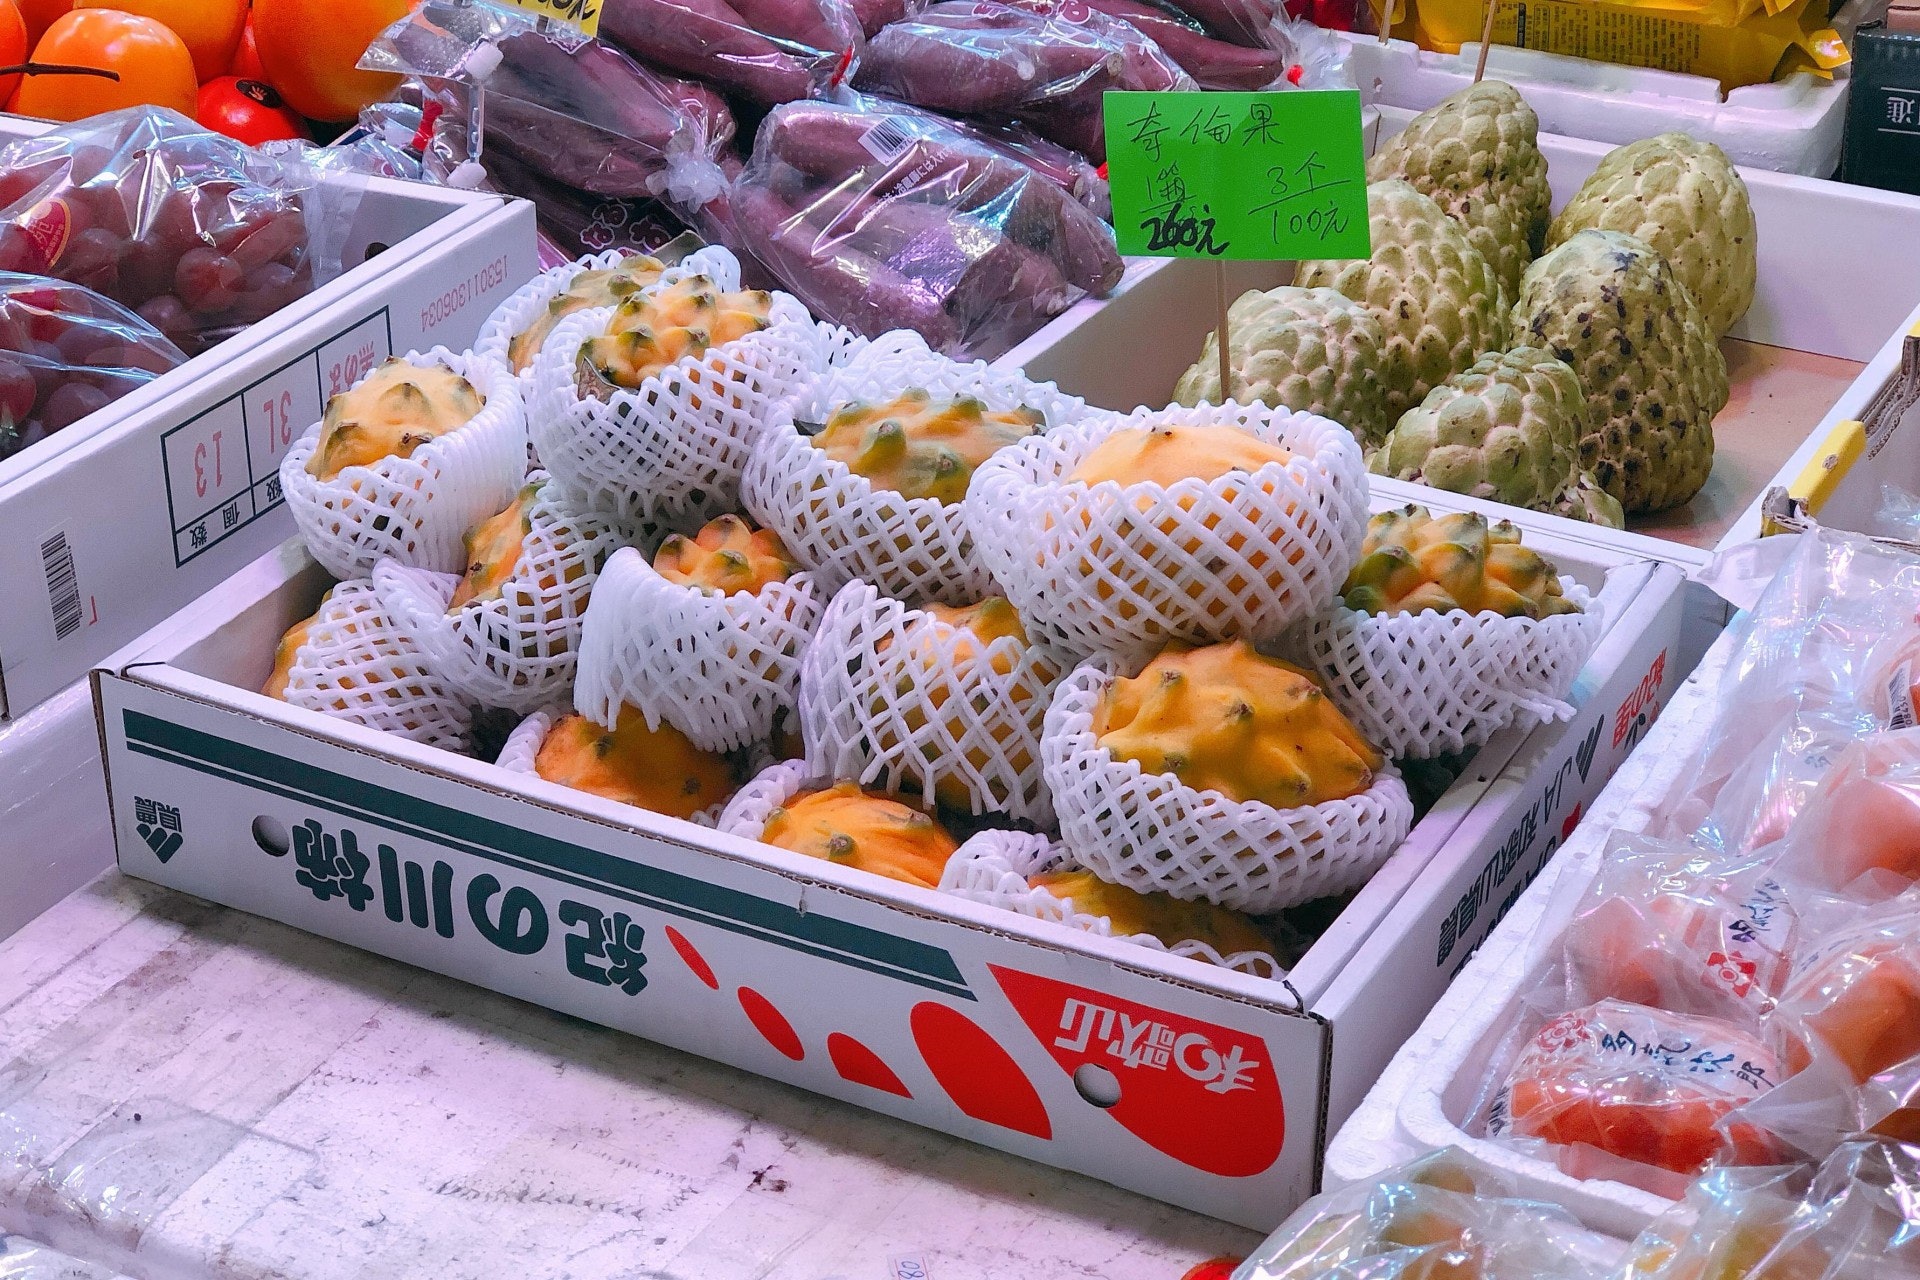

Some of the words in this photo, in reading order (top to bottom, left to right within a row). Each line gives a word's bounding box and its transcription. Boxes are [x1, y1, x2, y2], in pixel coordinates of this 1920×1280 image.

[1887, 96, 1920, 125] 進
[420, 255, 508, 333] 153011306034
[263, 390, 293, 455] 3L
[193, 430, 223, 498] 13
[289, 819, 649, 998] 紀の川柿
[1054, 997, 1260, 1095] 和歌山
